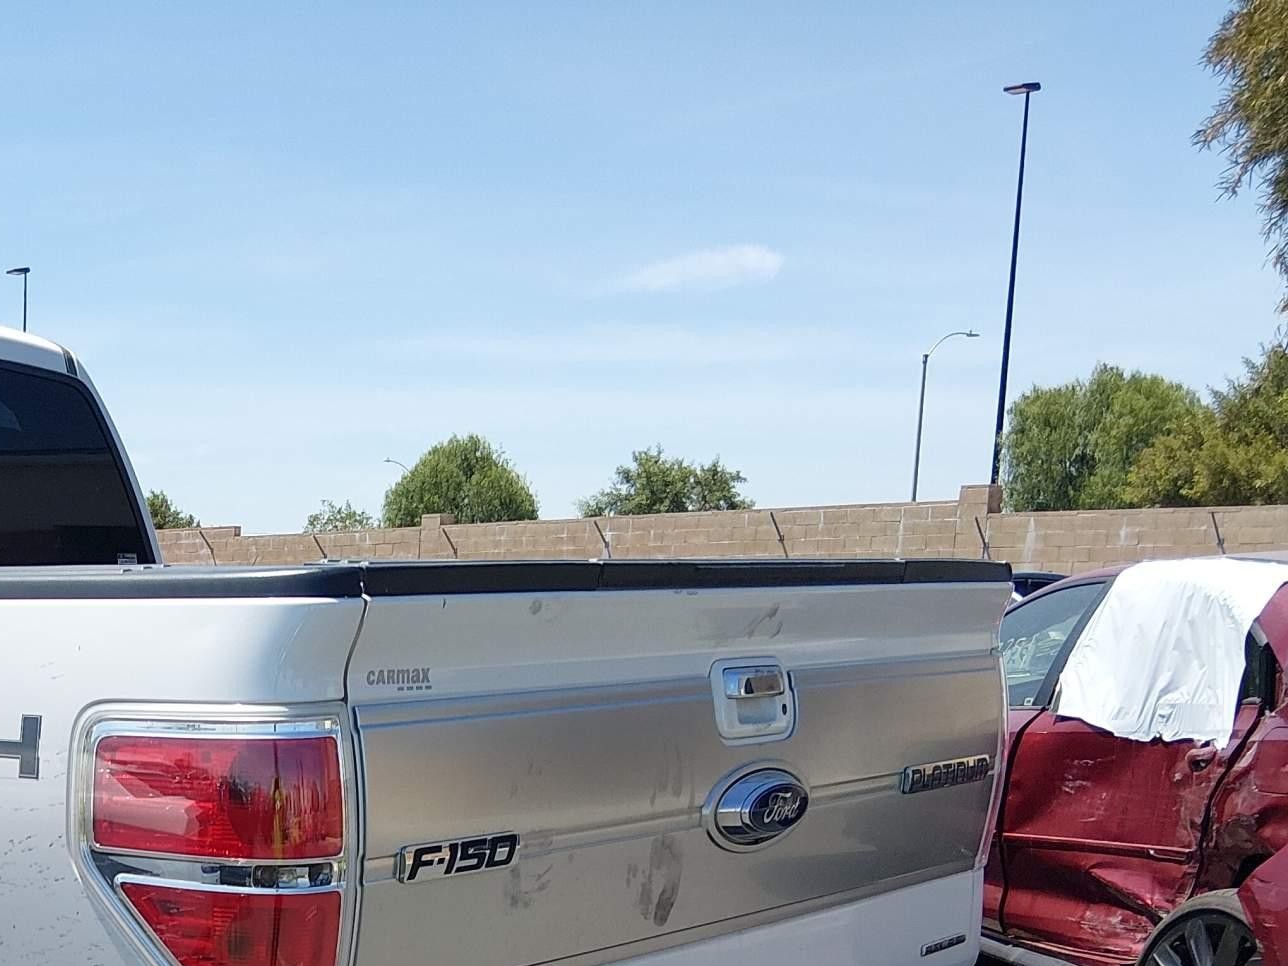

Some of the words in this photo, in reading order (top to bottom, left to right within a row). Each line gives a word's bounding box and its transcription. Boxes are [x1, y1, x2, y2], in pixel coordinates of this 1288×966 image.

[911, 756, 990, 789] PLATINUM
[763, 791, 800, 824] Ford
[406, 833, 518, 881] F-150
